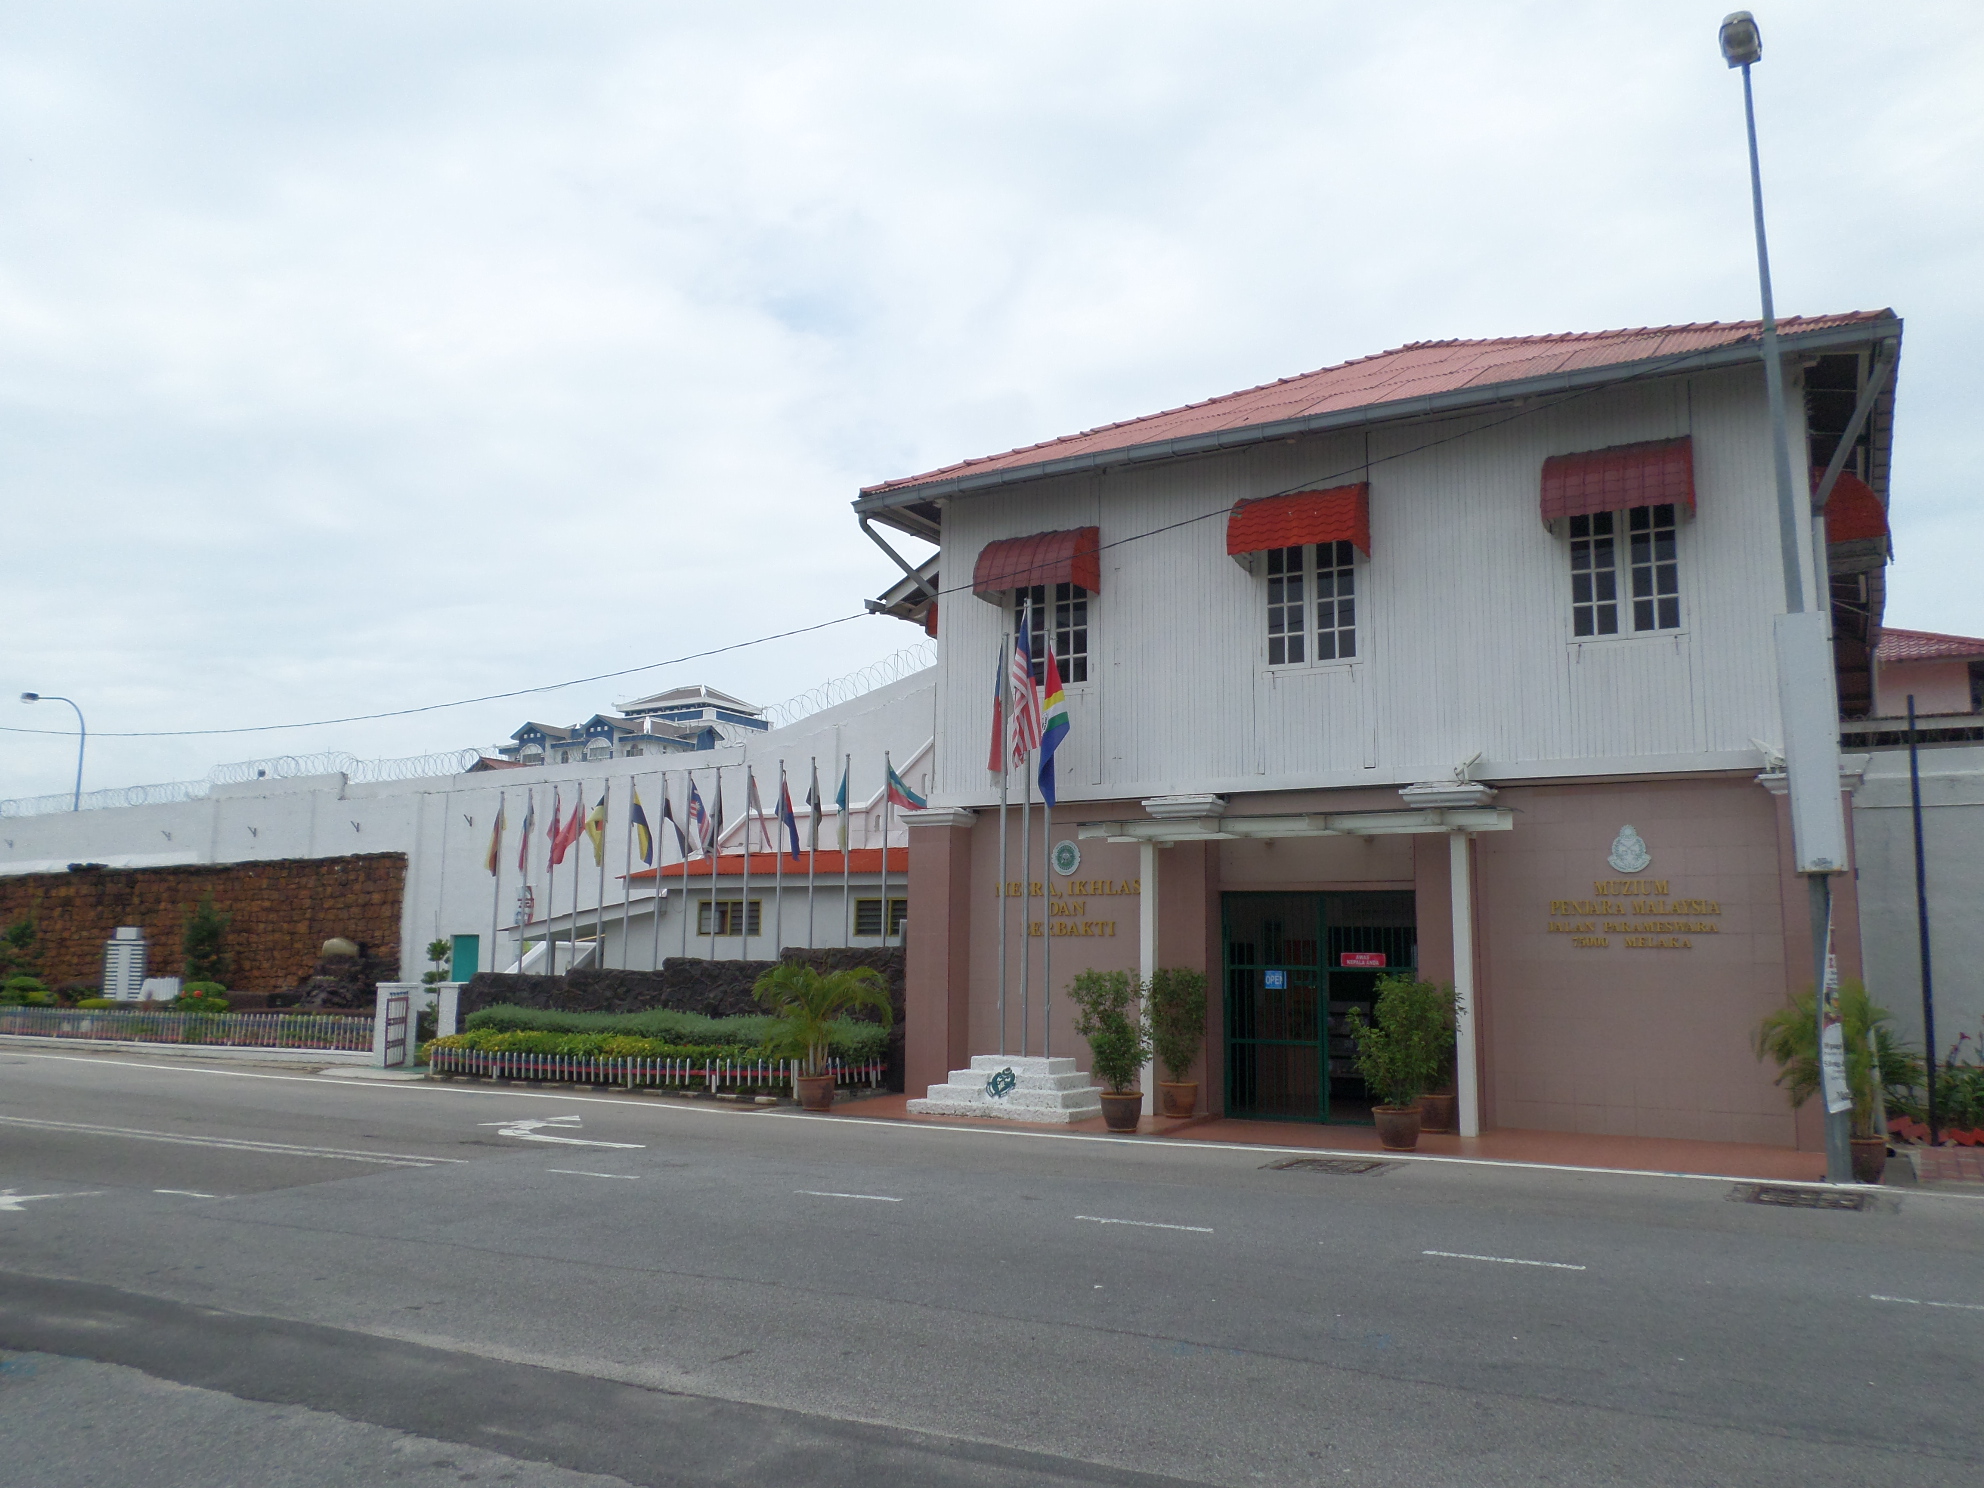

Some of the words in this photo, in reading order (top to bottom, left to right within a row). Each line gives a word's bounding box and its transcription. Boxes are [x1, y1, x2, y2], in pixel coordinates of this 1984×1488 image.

[995, 881, 1062, 898] MERA,
[1068, 880, 1140, 896] IKHLAS
[1594, 880, 1669, 895] MUZIUM
[1049, 901, 1086, 916] DAN
[1550, 900, 1626, 915] PENJARA
[1632, 899, 1721, 914] MALAYSIA
[1548, 921, 1595, 932] JALAN
[1604, 921, 1719, 932] PARAMESWARA
[1572, 937, 1609, 947] 75000
[1625, 937, 1692, 948] MELAKA
